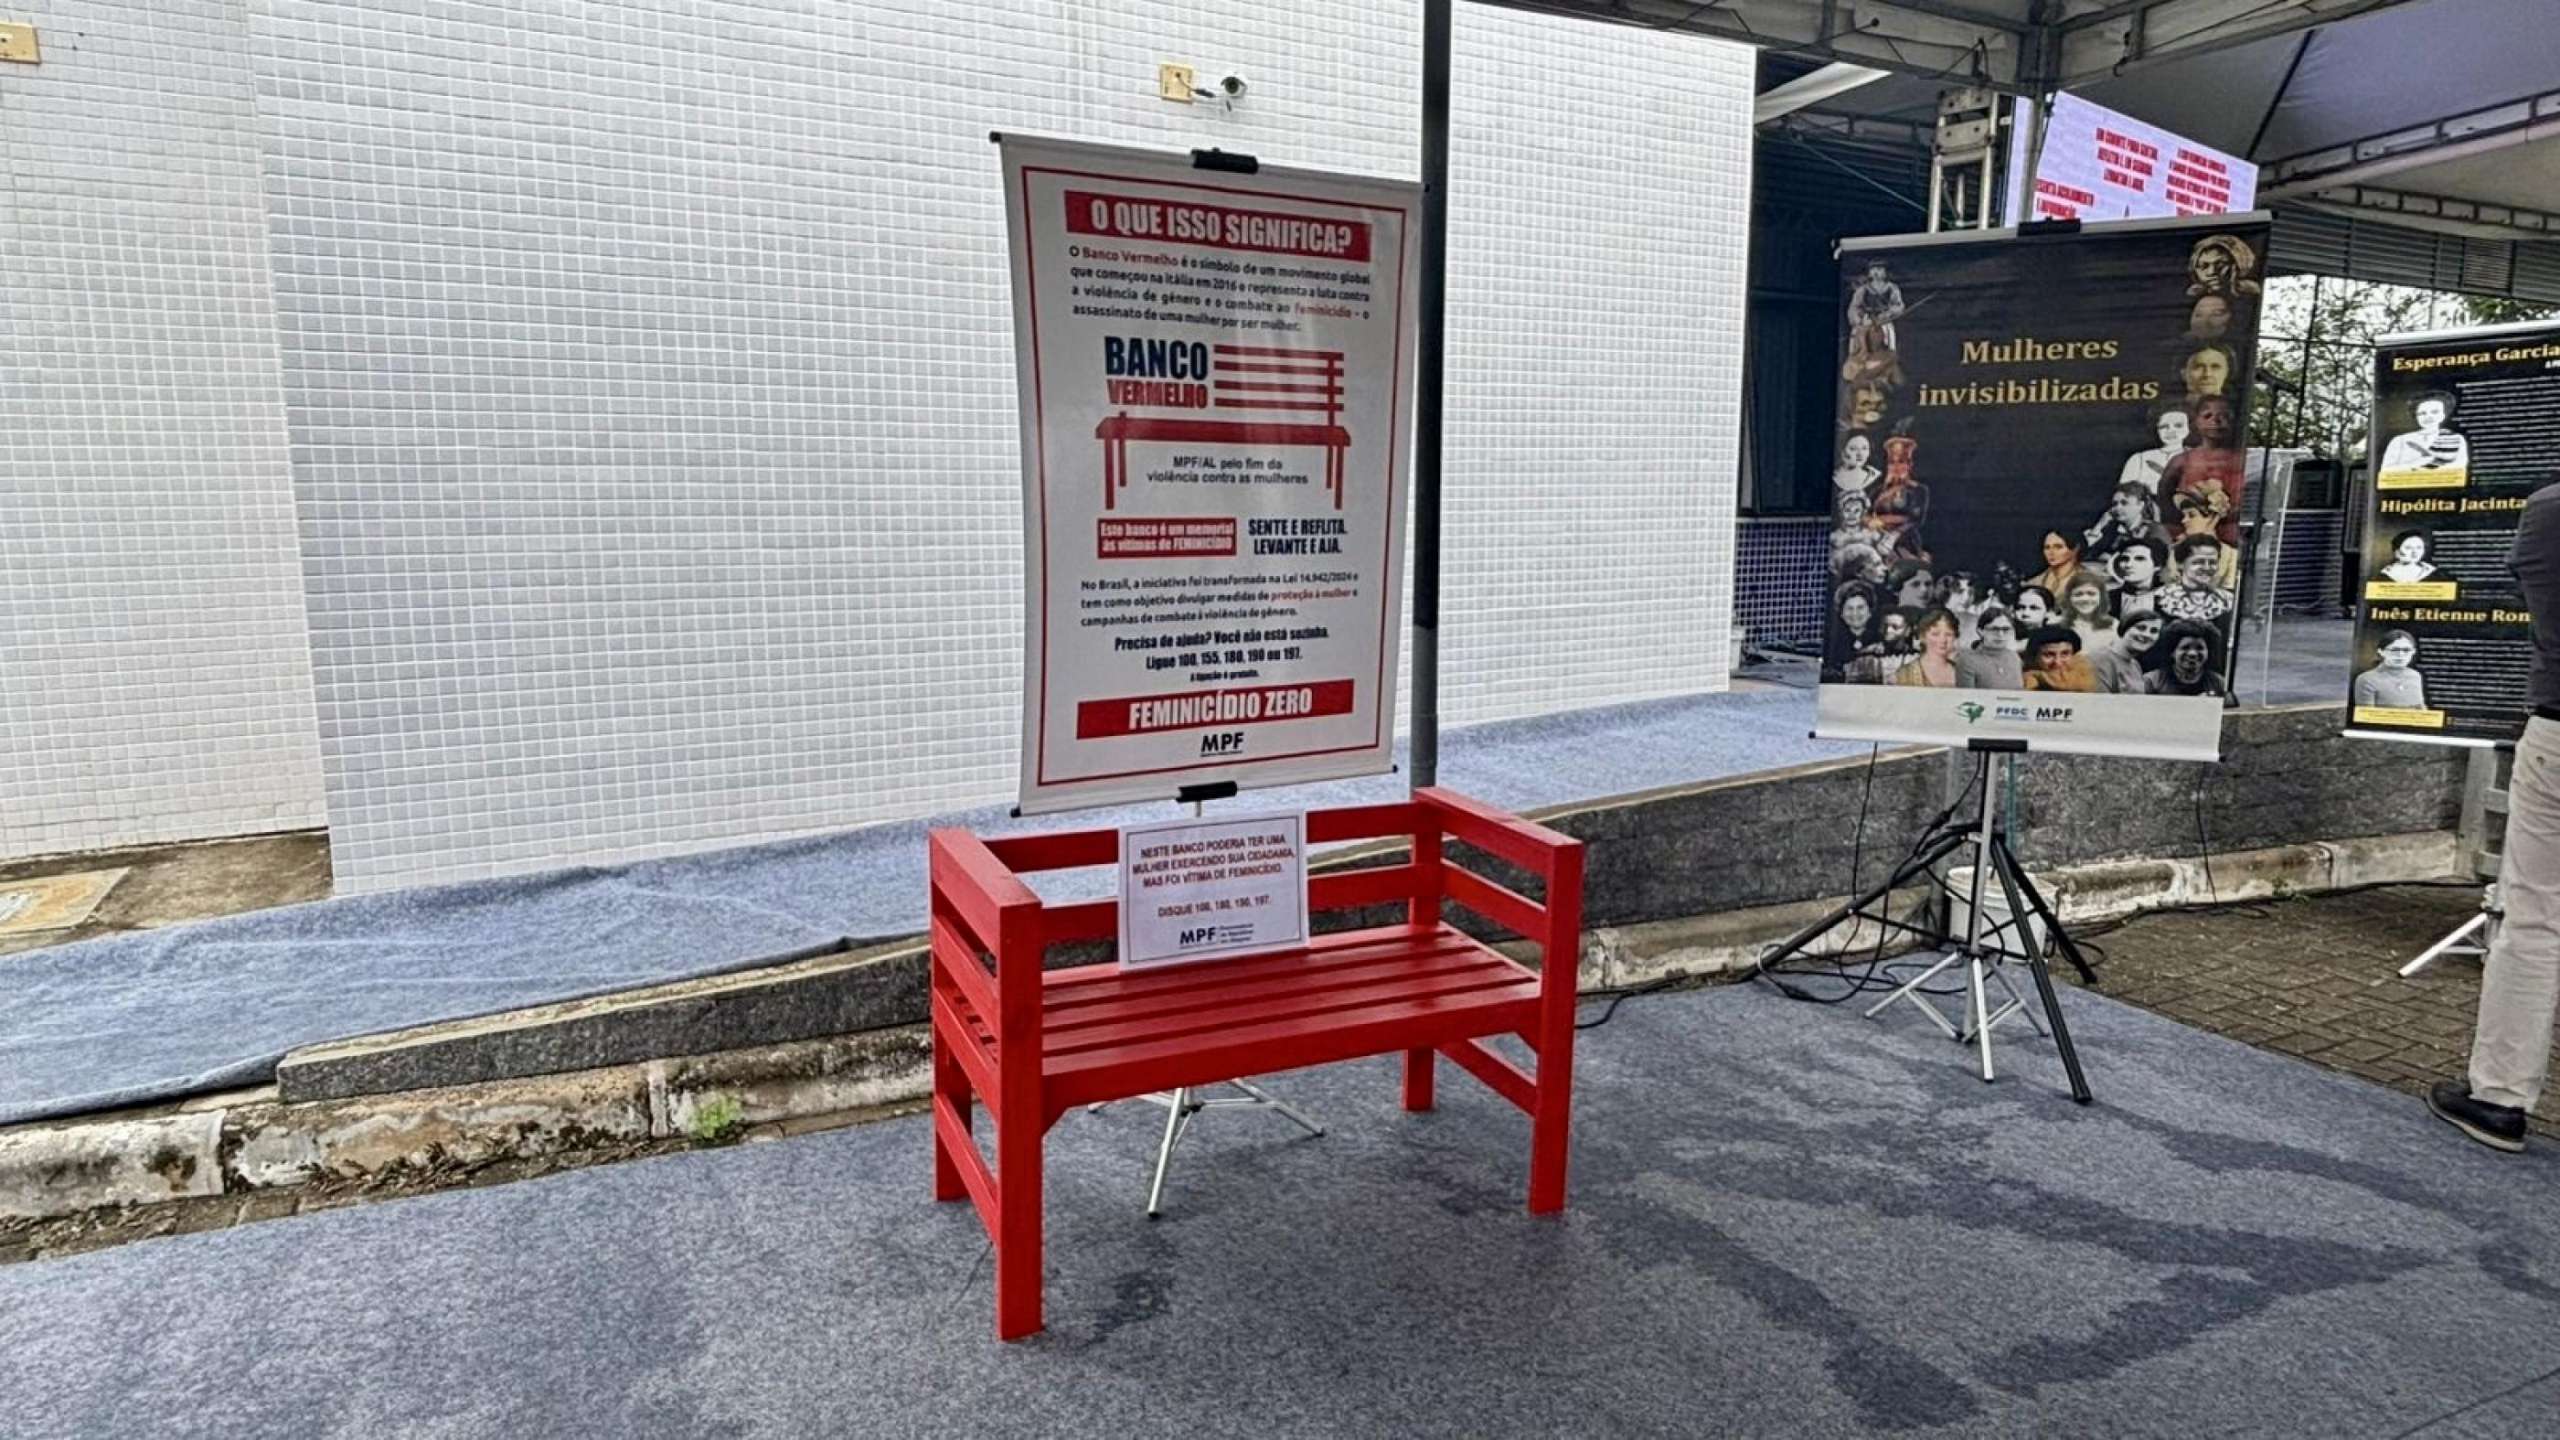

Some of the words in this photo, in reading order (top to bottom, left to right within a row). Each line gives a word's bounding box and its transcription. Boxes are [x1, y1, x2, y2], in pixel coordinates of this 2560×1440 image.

[1091, 199, 1109, 231] O
[1114, 202, 1163, 236] QUE
[1167, 207, 1221, 242] ISSO
[1224, 214, 1352, 254] SIGNIFICA?
[1069, 246, 1080, 257] O
[1082, 247, 1119, 262] Banco
[1121, 250, 1179, 267] Vermelho
[1181, 255, 1188, 268] é
[1191, 259, 1197, 268] o
[1200, 257, 1240, 273] símbolo
[1243, 262, 1257, 274] de
[1260, 266, 1276, 276] um
[1278, 268, 1338, 281] movimento
[1341, 273, 1370, 285] global
[1070, 267, 1093, 279] que
[1096, 269, 1148, 283] começou
[1150, 273, 1163, 284] na
[1196, 279, 1211, 288] em
[1214, 279, 1237, 291] 2016
[1239, 283, 1245, 292] e
[1309, 289, 1315, 298] a
[1317, 288, 1337, 299] luta
[1339, 291, 1370, 302] contra
[1084, 285, 1138, 300] violência
[1142, 289, 1157, 301] de
[1161, 293, 1201, 305] gênero
[1205, 298, 1211, 306] e
[1225, 299, 1273, 312] combate
[1073, 305, 1142, 319] assassinato
[1144, 308, 1157, 320] de
[1159, 312, 1183, 322] uma
[1184, 312, 1219, 326] mulher
[1222, 317, 1238, 329] por
[1241, 319, 1258, 329] ser
[1104, 336, 1208, 381] BANCO
[1960, 338, 2119, 364] Mulheres
[2393, 351, 2490, 372] Esperança
[2495, 343, 2560, 361] Garcia
[1106, 379, 1208, 409] VERMELHO
[1919, 376, 2160, 407] invisibilizadas
[1220, 459, 1243, 470] pelo
[1246, 457, 1264, 469] fim
[1267, 458, 1282, 469] da
[1147, 470, 1199, 483] violência
[1202, 473, 1236, 483] contra
[1239, 475, 1250, 484] as
[1254, 472, 1308, 484] mulheres
[2380, 498, 2455, 515] Hipólita
[2459, 497, 2528, 513] Jacinta
[1248, 519, 1288, 536] SENTE
[1291, 519, 1298, 536] E
[1301, 518, 1347, 535] REFLITA.
[1254, 538, 1307, 555] LEVANTE
[1310, 538, 1317, 554] E
[1318, 537, 1342, 554] AJA.
[1081, 581, 1097, 590] No
[1099, 577, 1132, 590] Brasil,
[1134, 580, 1140, 589] a
[1141, 576, 1187, 588] iniciativa
[1189, 575, 1202, 587] foi
[1203, 573, 1266, 586] transformada
[1268, 575, 1280, 583] na
[1283, 573, 1298, 583] Lei
[1081, 599, 1101, 608] tem
[1104, 598, 1132, 608] como
[1134, 594, 1175, 608] objetivo
[1177, 592, 1215, 605] divulgar
[1217, 591, 1256, 602] medidas
[1258, 590, 1269, 600] de
[1271, 588, 1313, 602] proteção
[1321, 588, 1351, 598] mulher
[1081, 613, 1138, 627] campanhas
[1141, 612, 1152, 623] de
[1155, 611, 1196, 622] combate
[1205, 607, 1247, 619] violência
[1248, 607, 1259, 618] de
[1260, 606, 1298, 618] gênero.
[2371, 607, 2410, 621] Inês
[2414, 607, 2487, 622] Etienne
[1115, 636, 1157, 651] Precisa
[1160, 633, 1173, 648] de
[1176, 631, 1212, 648] ajuda?
[1214, 629, 1240, 644] Você
[1243, 629, 1262, 643] não
[1264, 628, 1287, 641] está
[1146, 656, 1176, 670] Ligue
[1248, 647, 1265, 662] 190
[1267, 650, 1280, 661] ou
[1284, 646, 1303, 660] 197.
[1128, 690, 1261, 730] FEMINICÍDIO
[1263, 688, 1313, 718] ZERO
[2036, 707, 2073, 719] MPF
[1201, 732, 1244, 752] MPF
[1141, 845, 1169, 858] NESTE
[1172, 842, 1204, 855] BANCO
[1206, 838, 1245, 852] PODERIA
[1248, 835, 1264, 848] TER
[1266, 834, 1286, 845] UMA
[1132, 860, 1169, 874] MULHER
[1171, 854, 1225, 870] EXERCENDO
[1228, 852, 1245, 864] SUA
[1143, 874, 1163, 887] MAS
[1165, 872, 1180, 885] FOI
[1183, 869, 1212, 883] VÍTIMA
[1214, 868, 1226, 880] DE
[1158, 904, 1192, 918] DISQUE
[1180, 926, 1216, 945] MPF
